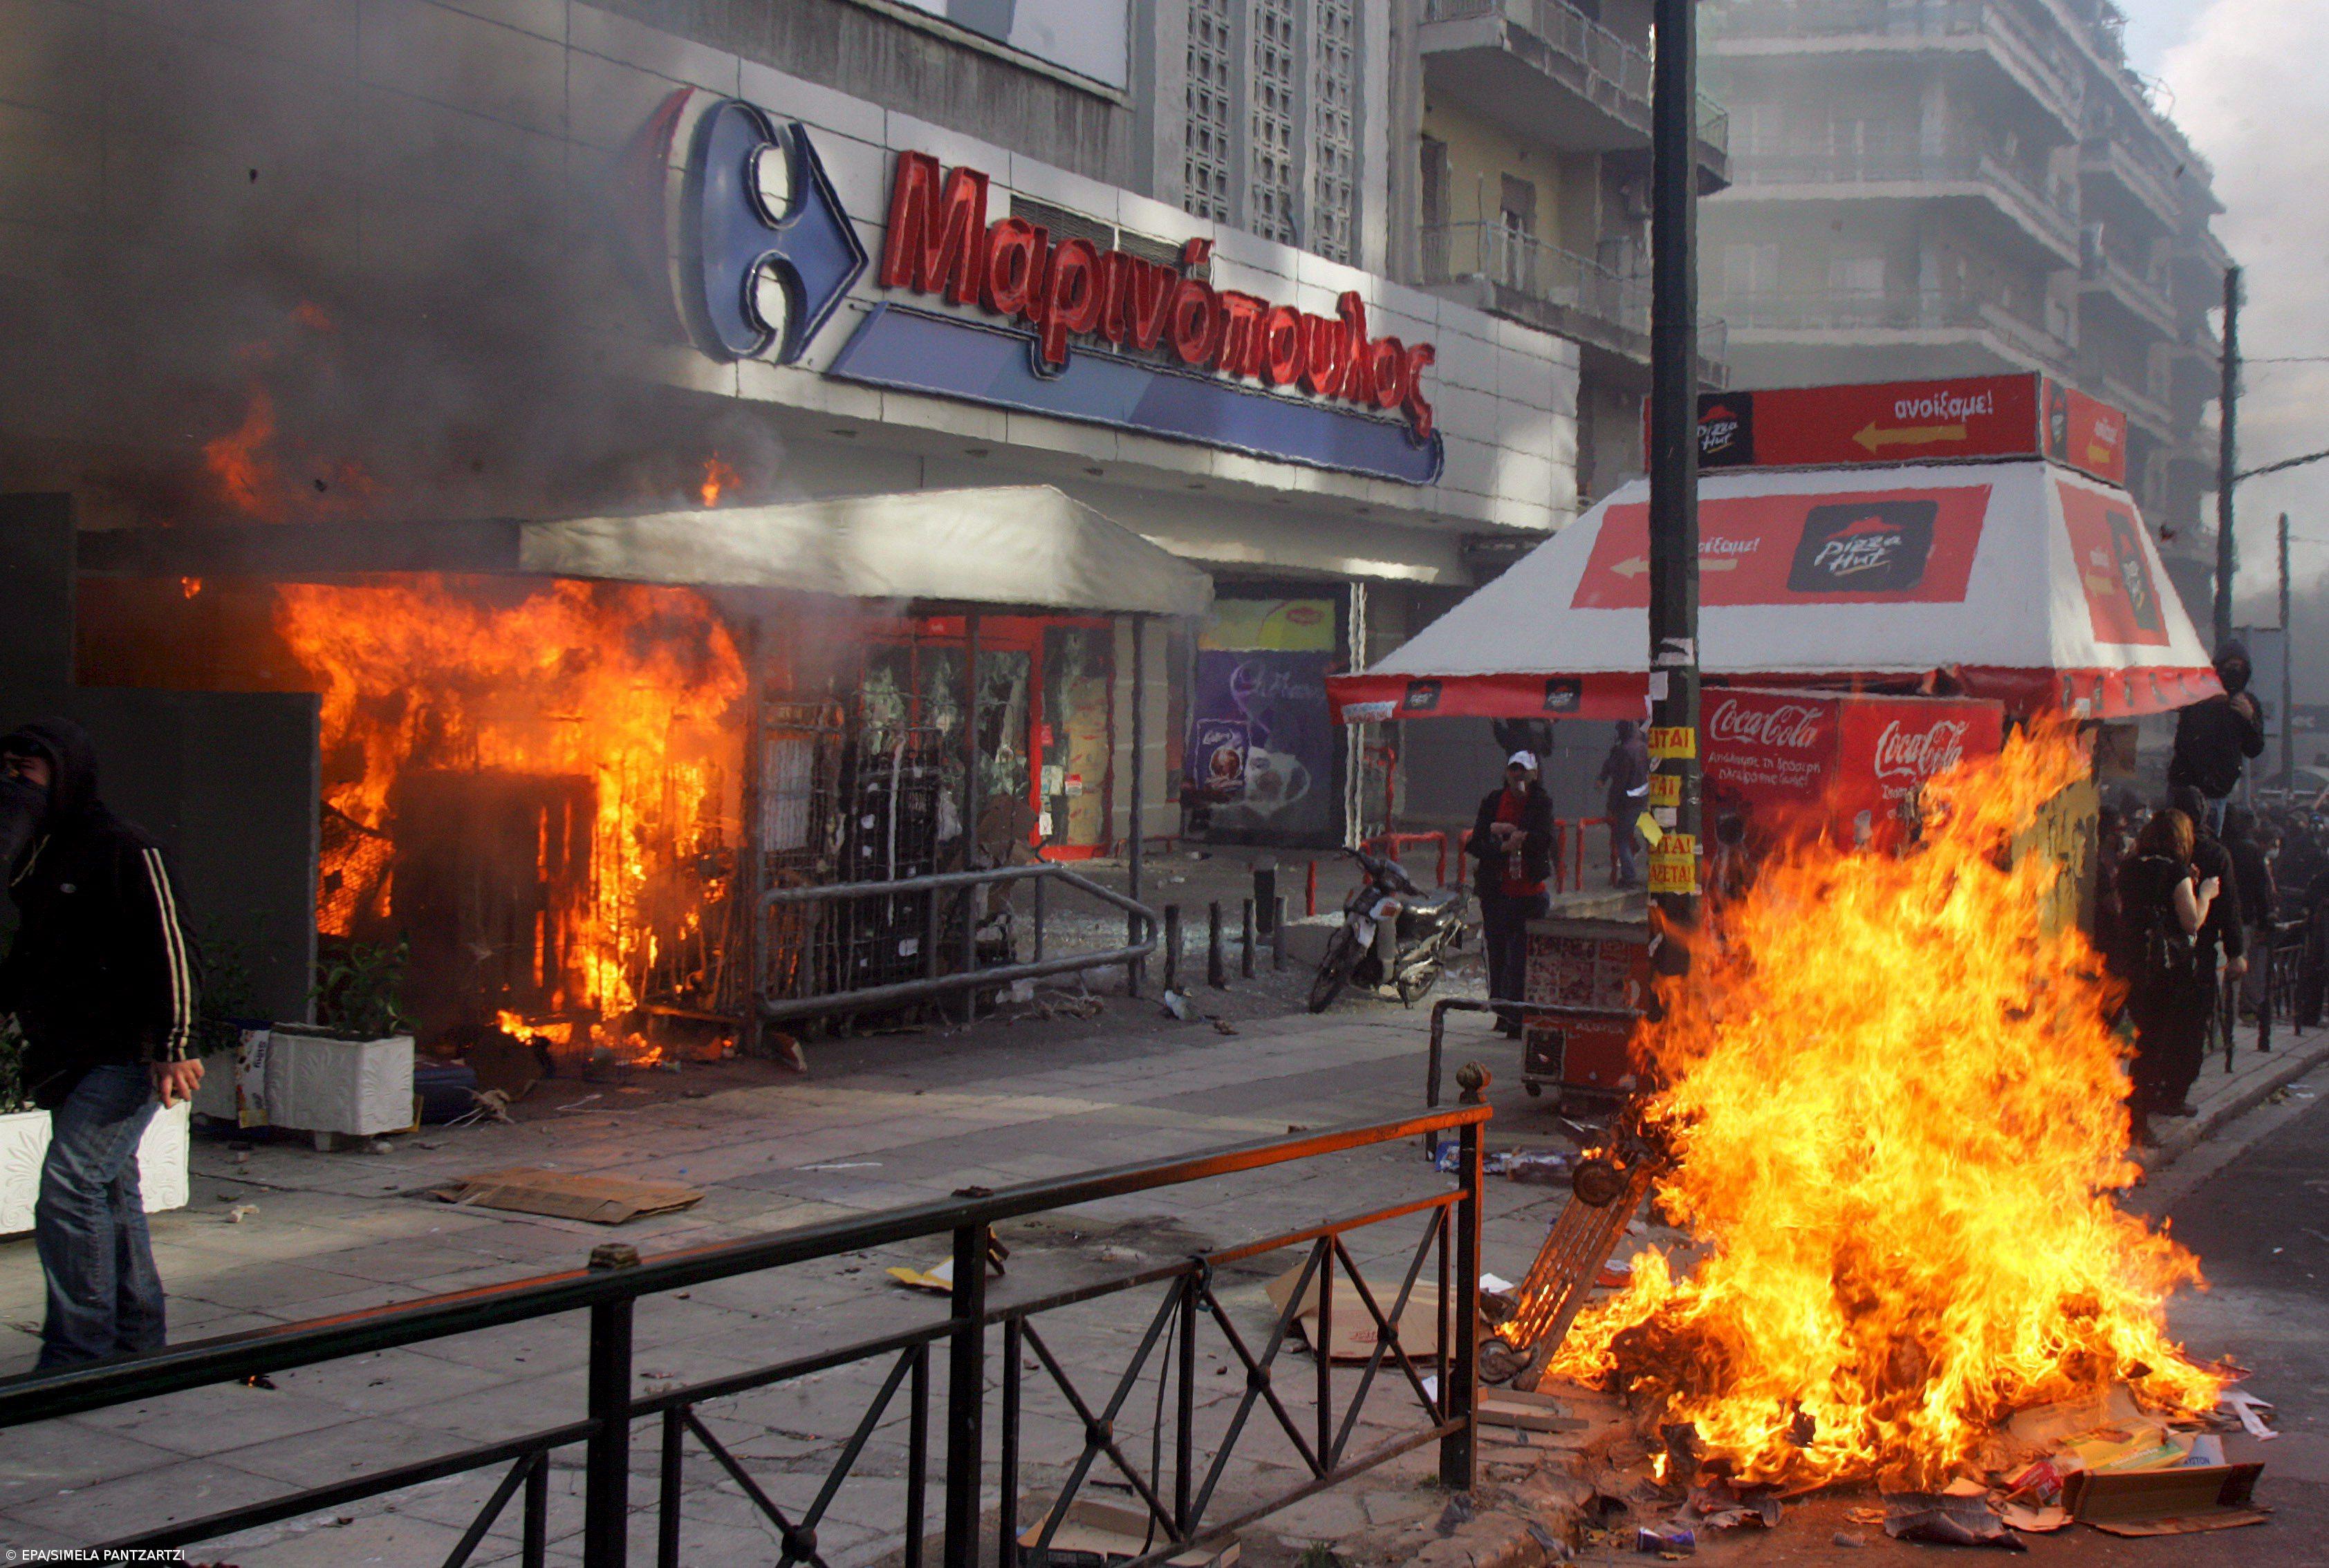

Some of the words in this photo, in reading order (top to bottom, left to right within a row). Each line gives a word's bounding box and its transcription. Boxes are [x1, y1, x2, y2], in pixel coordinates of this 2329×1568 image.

[880, 149, 1436, 438] Μαρινόπουλος
[1895, 390, 1994, 423] ανοίξαμε!
[1814, 534, 1902, 567] Pizza
[1828, 548, 1886, 573] Hut
[1710, 698, 1824, 748] Coca-Cola
